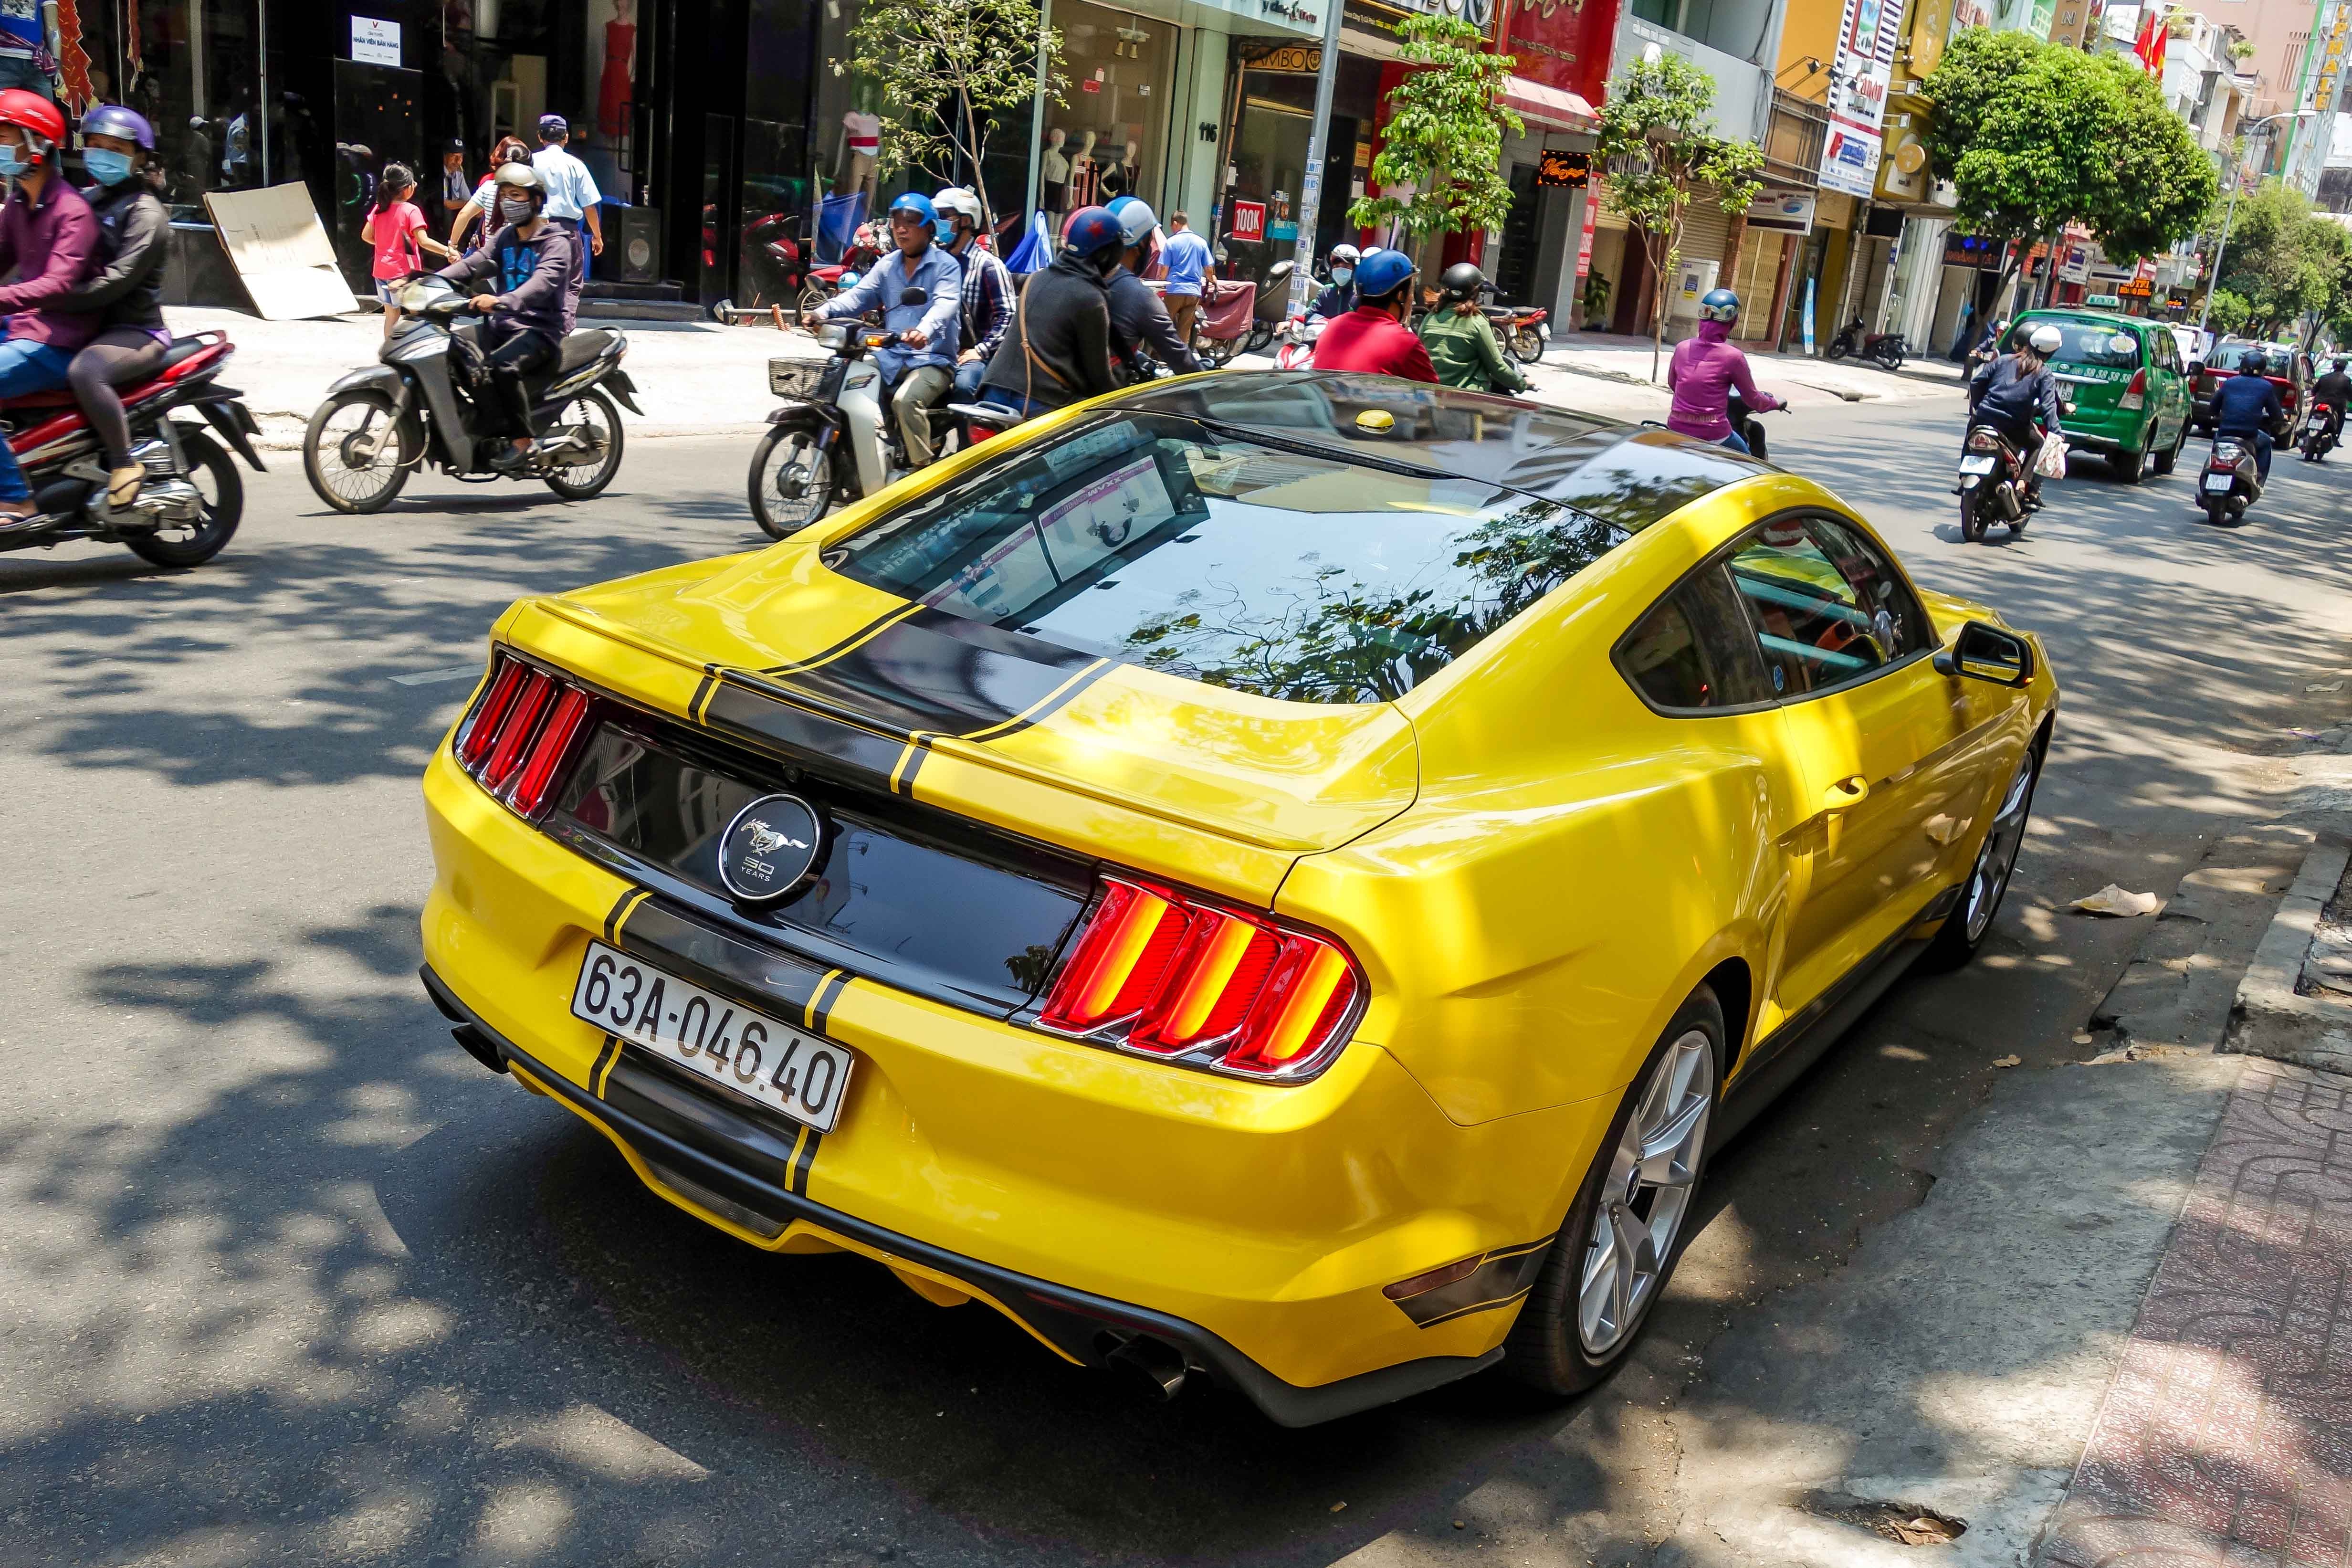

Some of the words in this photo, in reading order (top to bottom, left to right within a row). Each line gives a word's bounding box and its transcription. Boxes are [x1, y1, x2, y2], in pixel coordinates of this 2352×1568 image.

[1199, 122, 1218, 142] 116
[1236, 207, 1260, 232] 100K
[740, 866, 771, 882] YEARS
[743, 856, 775, 875] 50
[584, 954, 837, 1115] 63A-046.40
